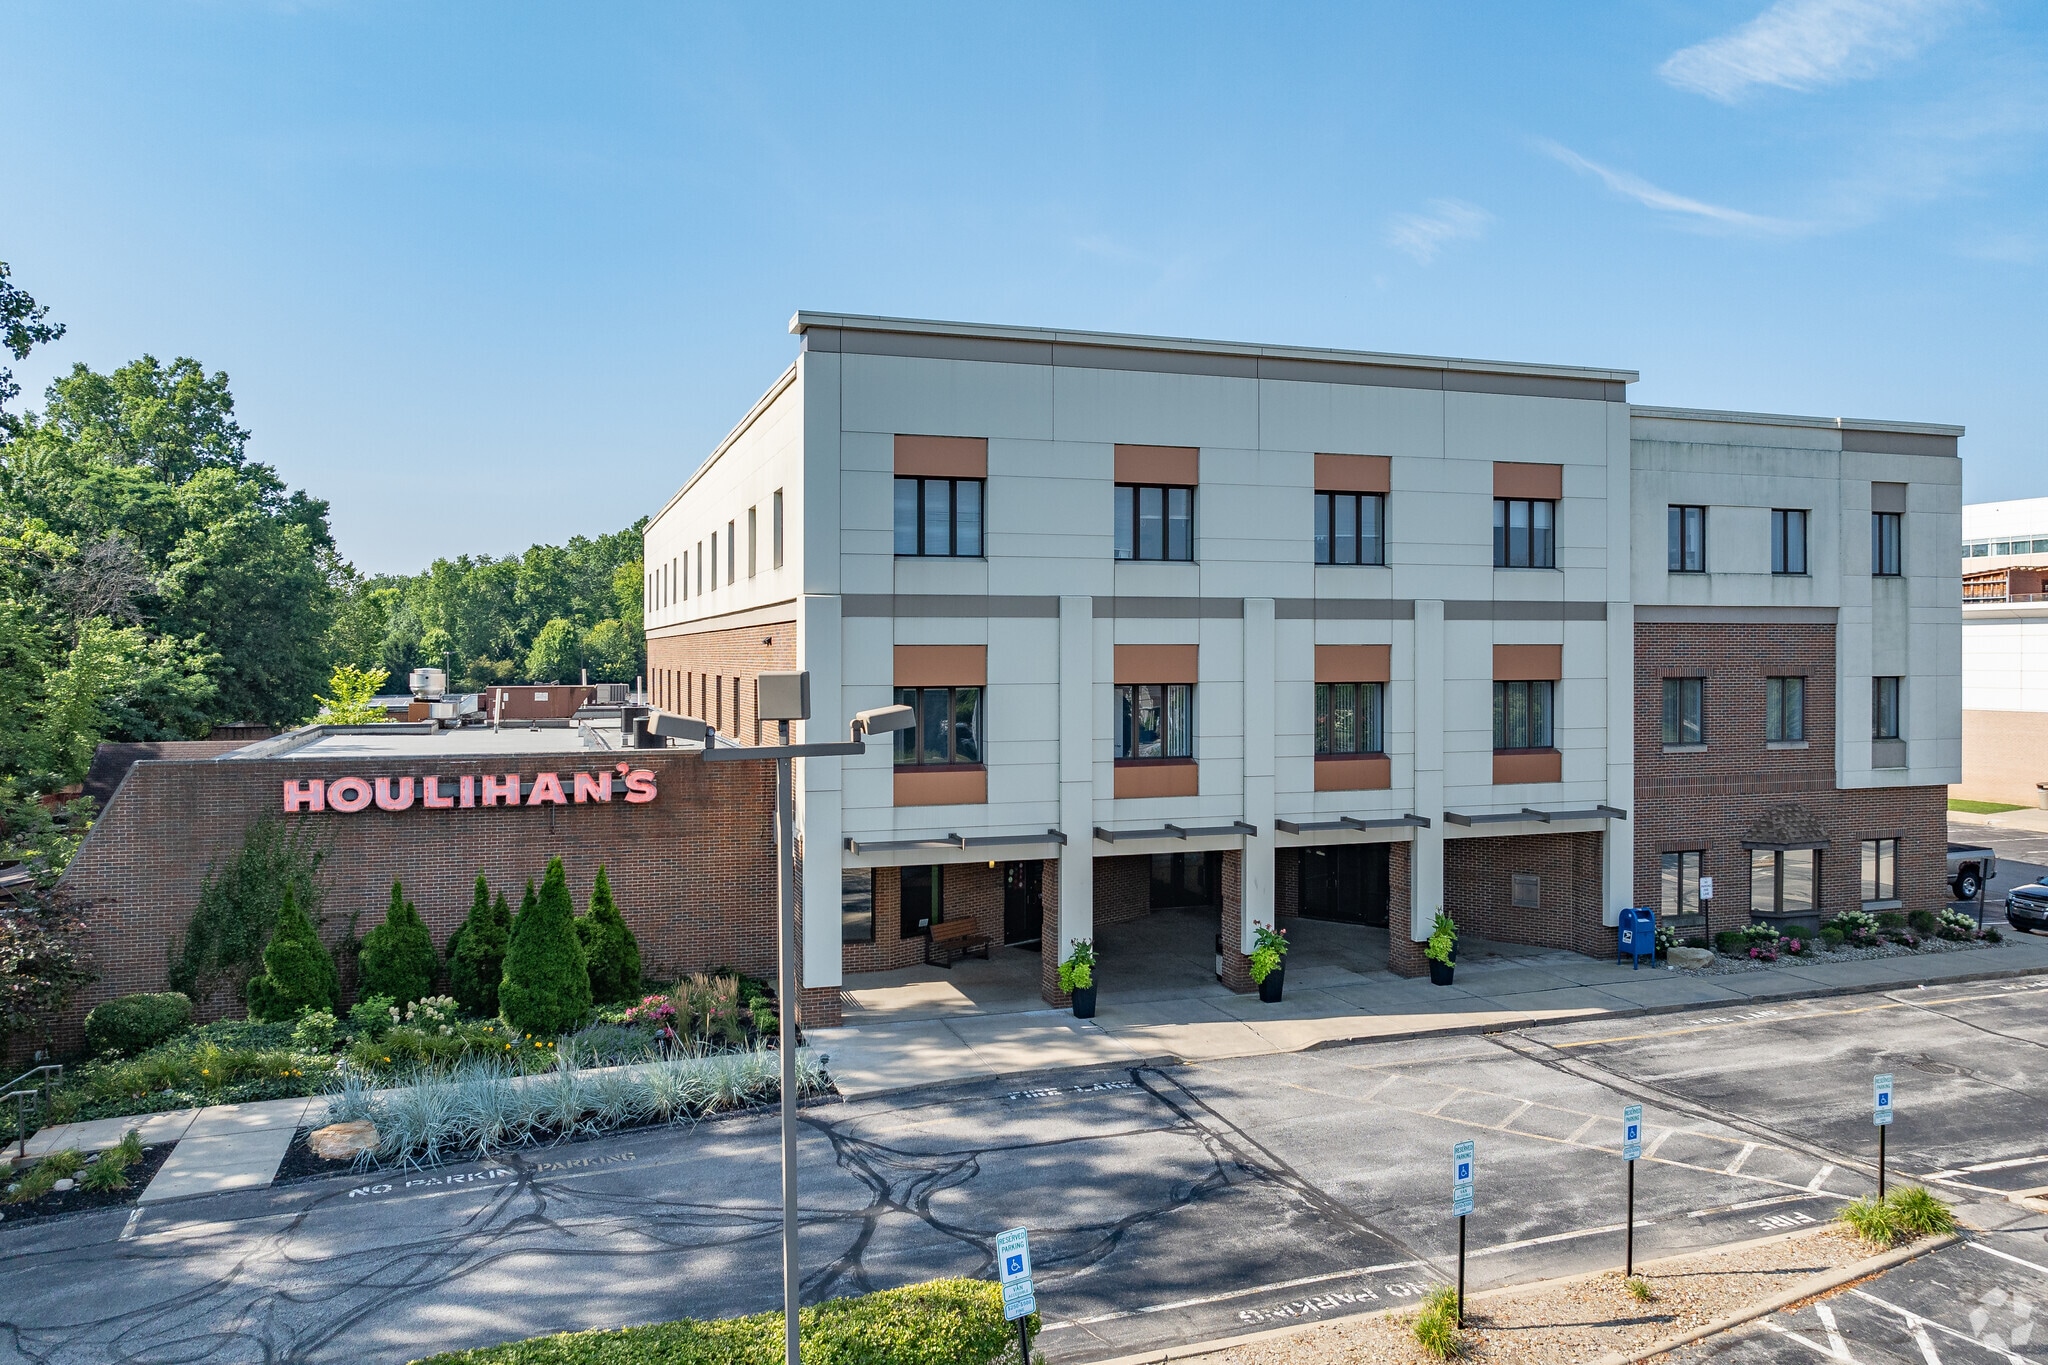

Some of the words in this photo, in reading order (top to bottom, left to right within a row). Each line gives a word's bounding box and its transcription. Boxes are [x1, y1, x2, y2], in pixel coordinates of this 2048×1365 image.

[282, 761, 658, 813] HOULIHAN'S
[1007, 1087, 1062, 1100] FIRE
[1456, 1151, 1472, 1160] PARKING
[348, 1184, 393, 1198] NO
[405, 1168, 516, 1188] PARKIN
[537, 1152, 637, 1173] PARKING
[1748, 1211, 1817, 1231] FIRE
[999, 1232, 1025, 1245] RESERVED
[1001, 1241, 1025, 1253] PARKING
[1012, 1284, 1024, 1292] VAN
[1239, 1287, 1380, 1324] PARKING
